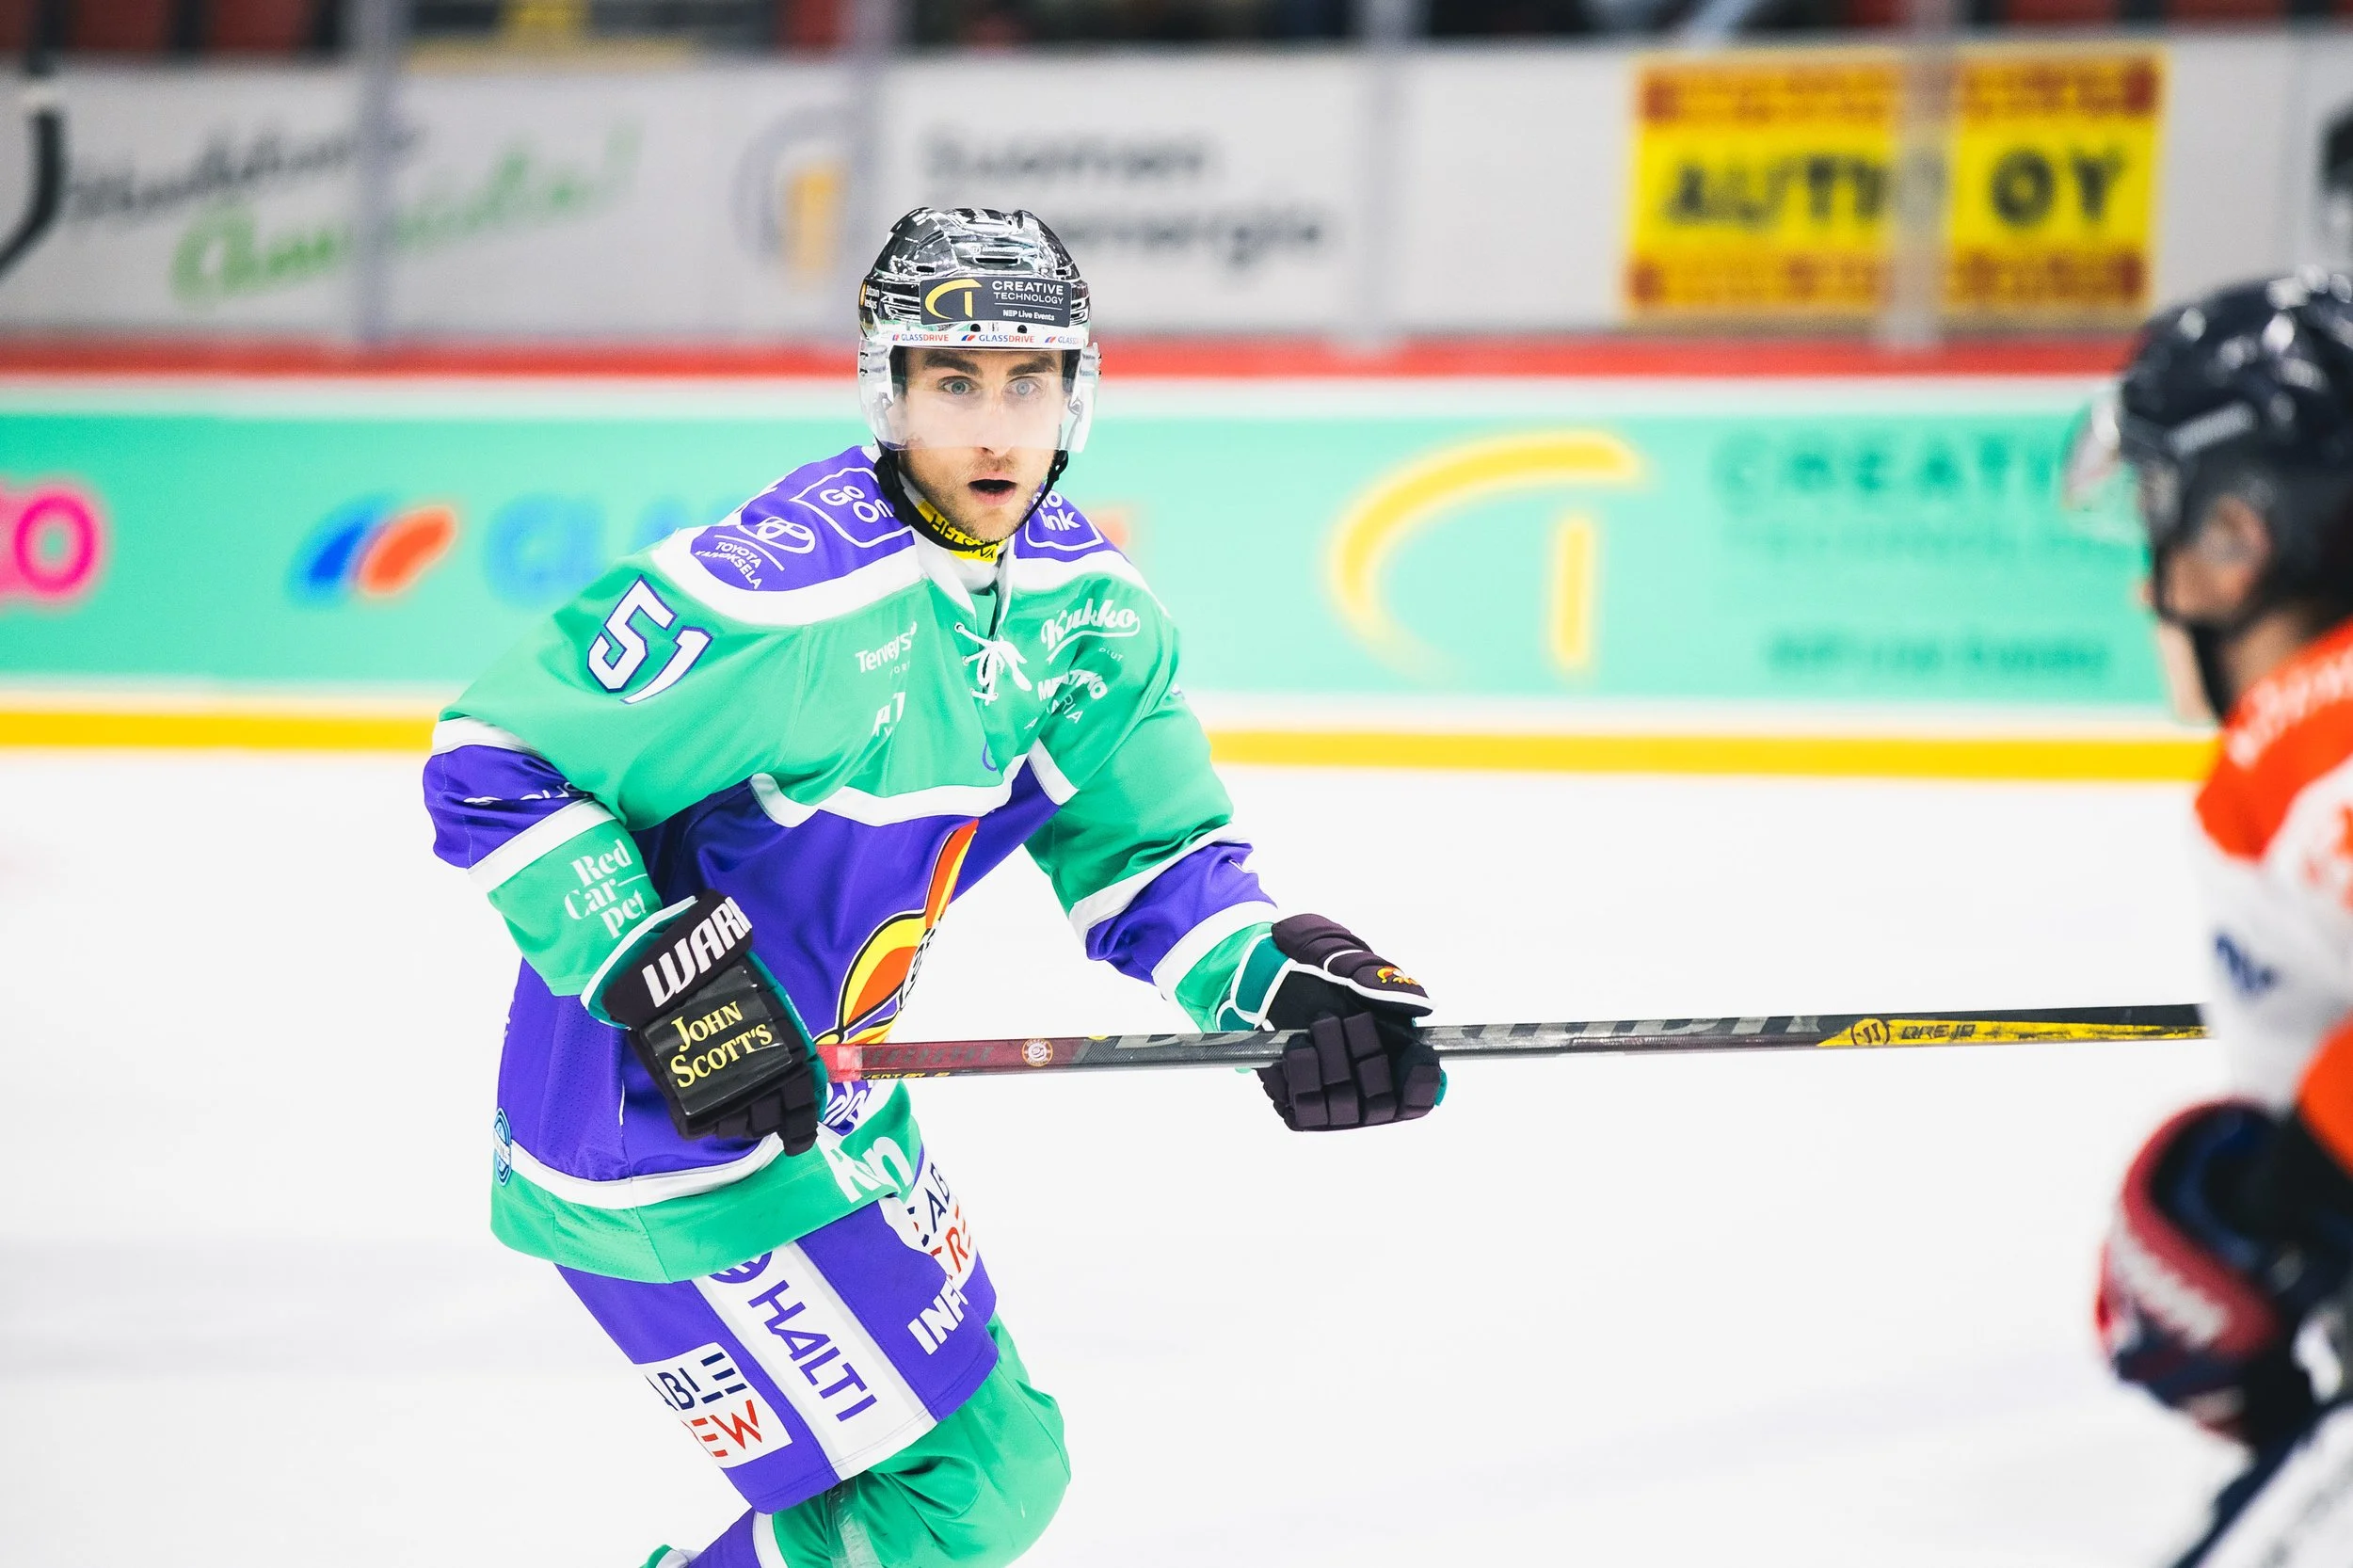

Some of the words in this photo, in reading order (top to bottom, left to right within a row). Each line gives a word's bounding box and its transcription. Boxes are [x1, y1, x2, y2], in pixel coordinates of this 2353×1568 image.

[991, 280, 1064, 296] CREATIVE
[993, 292, 1064, 305] TECHNOLOGY
[900, 333, 950, 343] GLASSDRIVE
[978, 333, 1035, 344] GLASSDRIVE
[1017, 310, 1032, 319] Live
[1033, 312, 1055, 321] Events
[714, 541, 762, 568] TOYOTA
[586, 574, 713, 705] 51
[1040, 598, 1141, 656] Kukko
[570, 839, 632, 887] Red
[600, 889, 647, 939] pet
[671, 1001, 744, 1052] JOHN
[670, 1023, 773, 1088] SCOTT'S
[747, 1279, 878, 1423] HALTI
